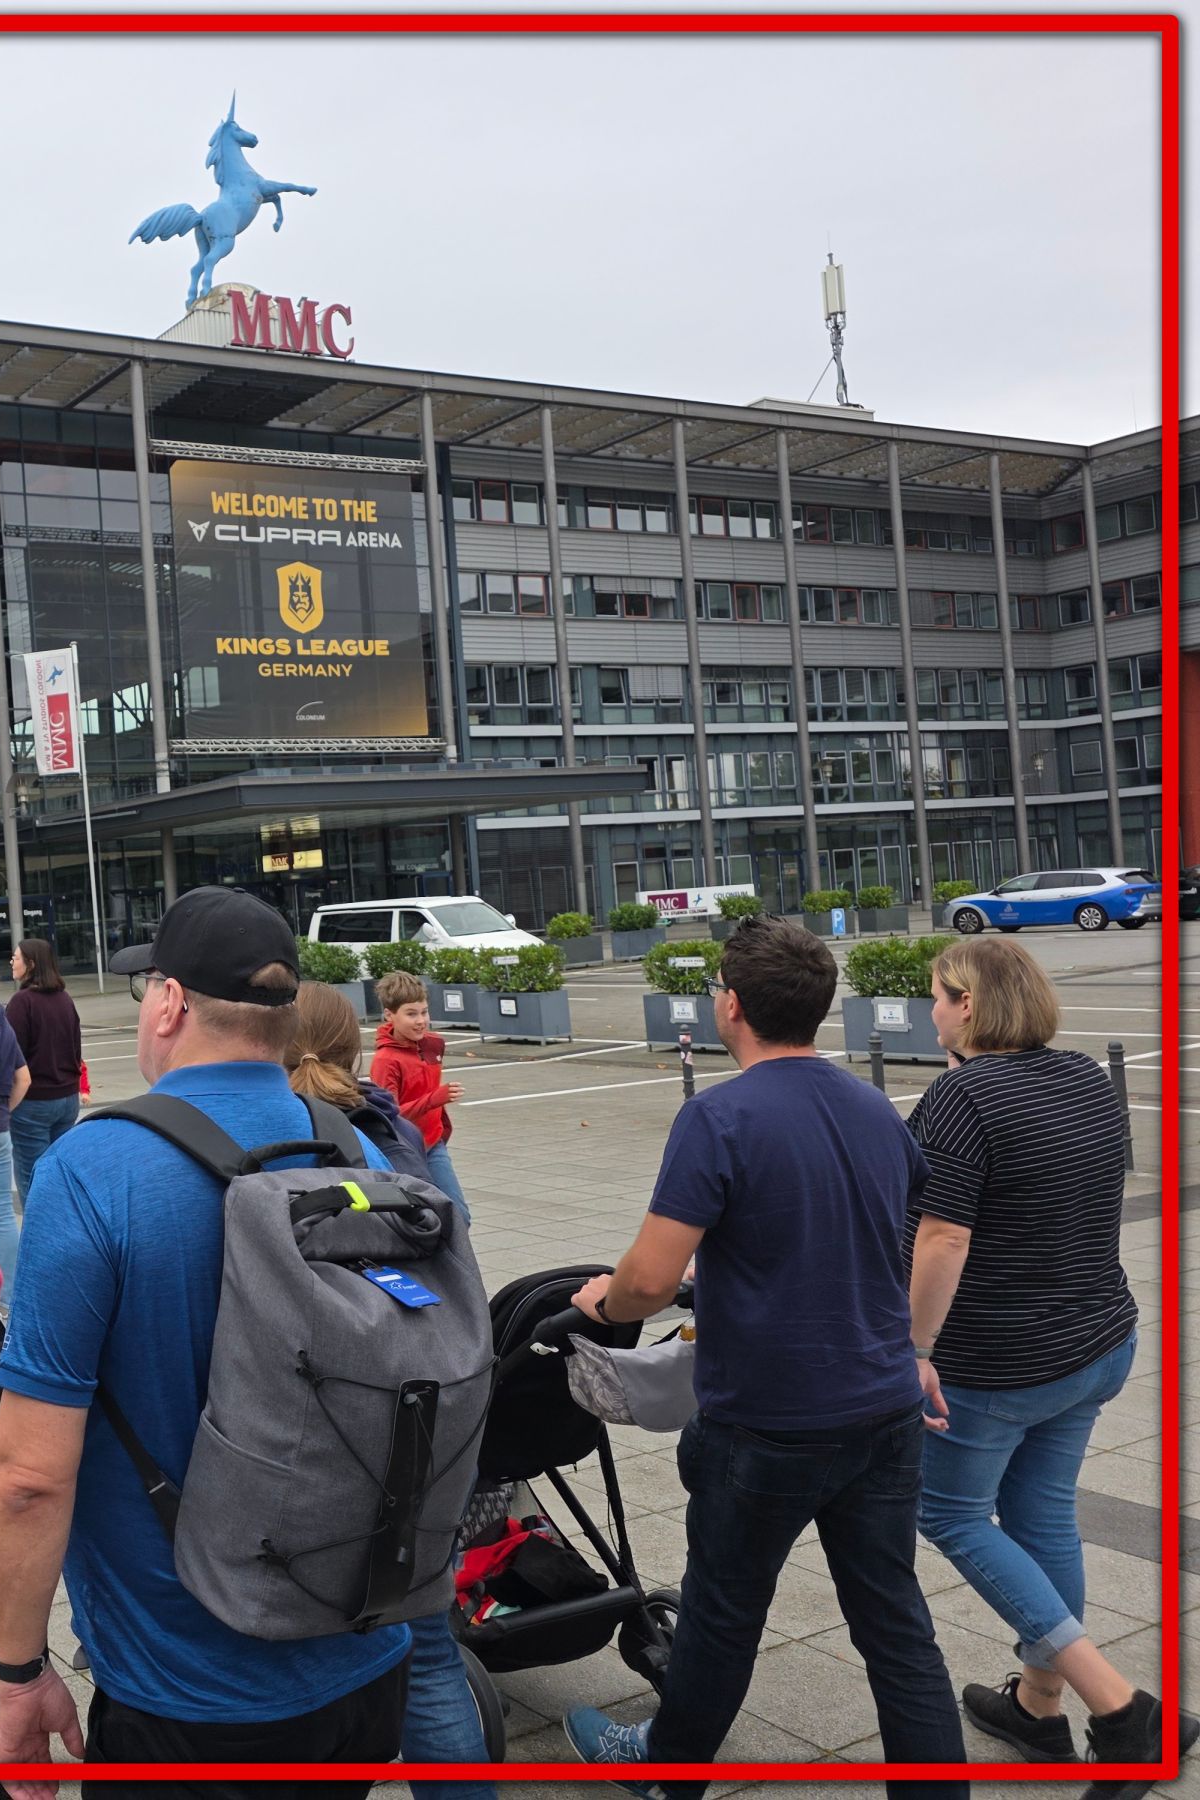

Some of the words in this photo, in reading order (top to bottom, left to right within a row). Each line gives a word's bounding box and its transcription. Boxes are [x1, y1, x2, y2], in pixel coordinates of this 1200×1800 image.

[227, 289, 354, 360] MMC
[211, 491, 308, 519] WELCOME
[312, 497, 337, 521] TO
[341, 499, 378, 522] THE
[215, 524, 342, 547] CUPRA
[346, 531, 402, 548] ARENA
[216, 638, 292, 656] KINGS
[296, 638, 390, 656] LEAGUE
[258, 663, 353, 677] GERMANY
[648, 897, 680, 911] MMC
[834, 910, 843, 928] P
